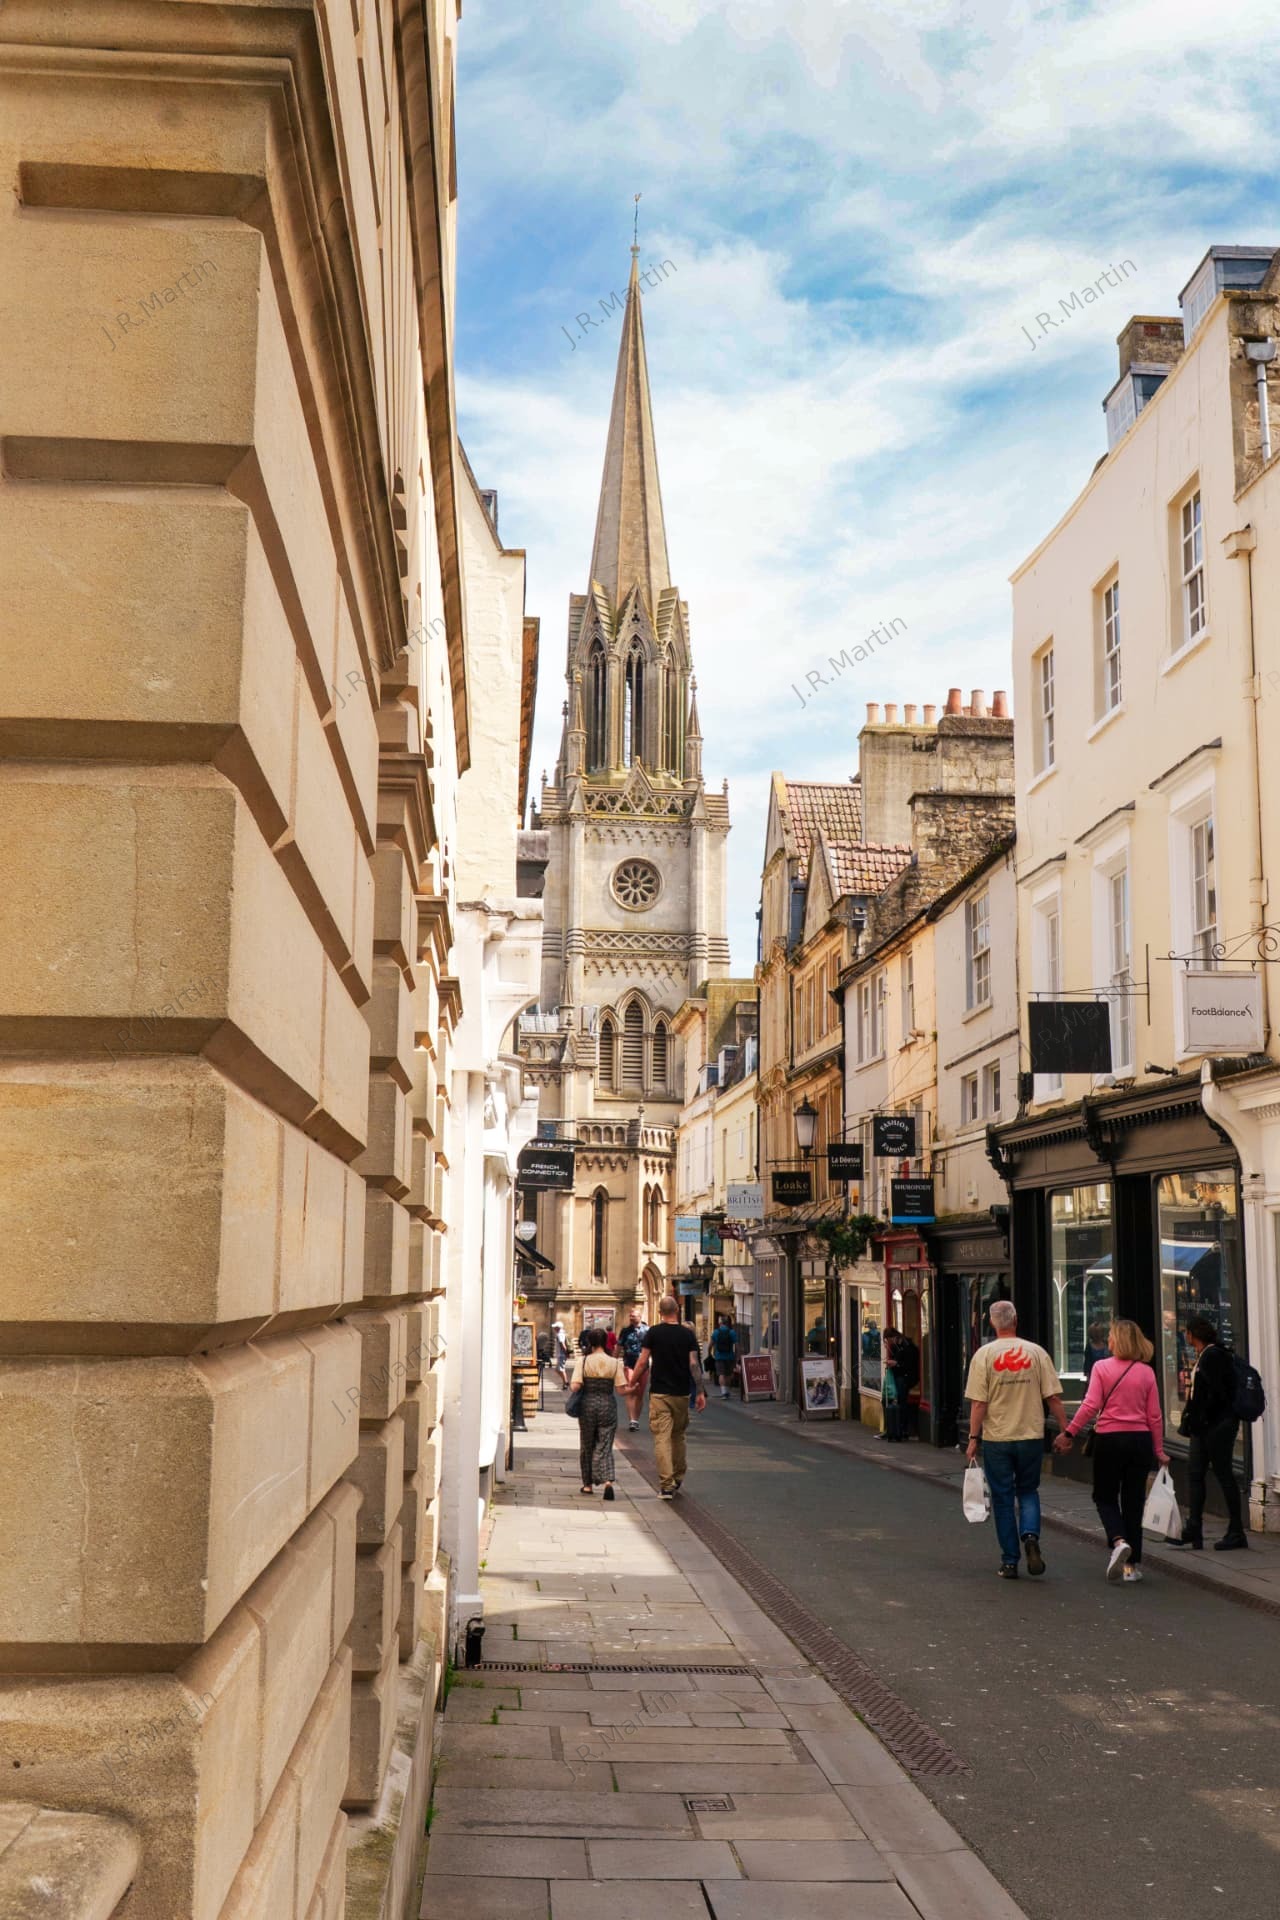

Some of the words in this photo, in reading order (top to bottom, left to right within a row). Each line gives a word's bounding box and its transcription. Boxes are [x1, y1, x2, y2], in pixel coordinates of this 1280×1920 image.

[1192, 1007, 1246, 1017] FootBalance
[880, 1119, 909, 1132] FASHION
[882, 1142, 908, 1153] FABRICS
[831, 1156, 839, 1164] La
[521, 1168, 568, 1177] CONNECTION
[775, 1180, 809, 1190] Loake
